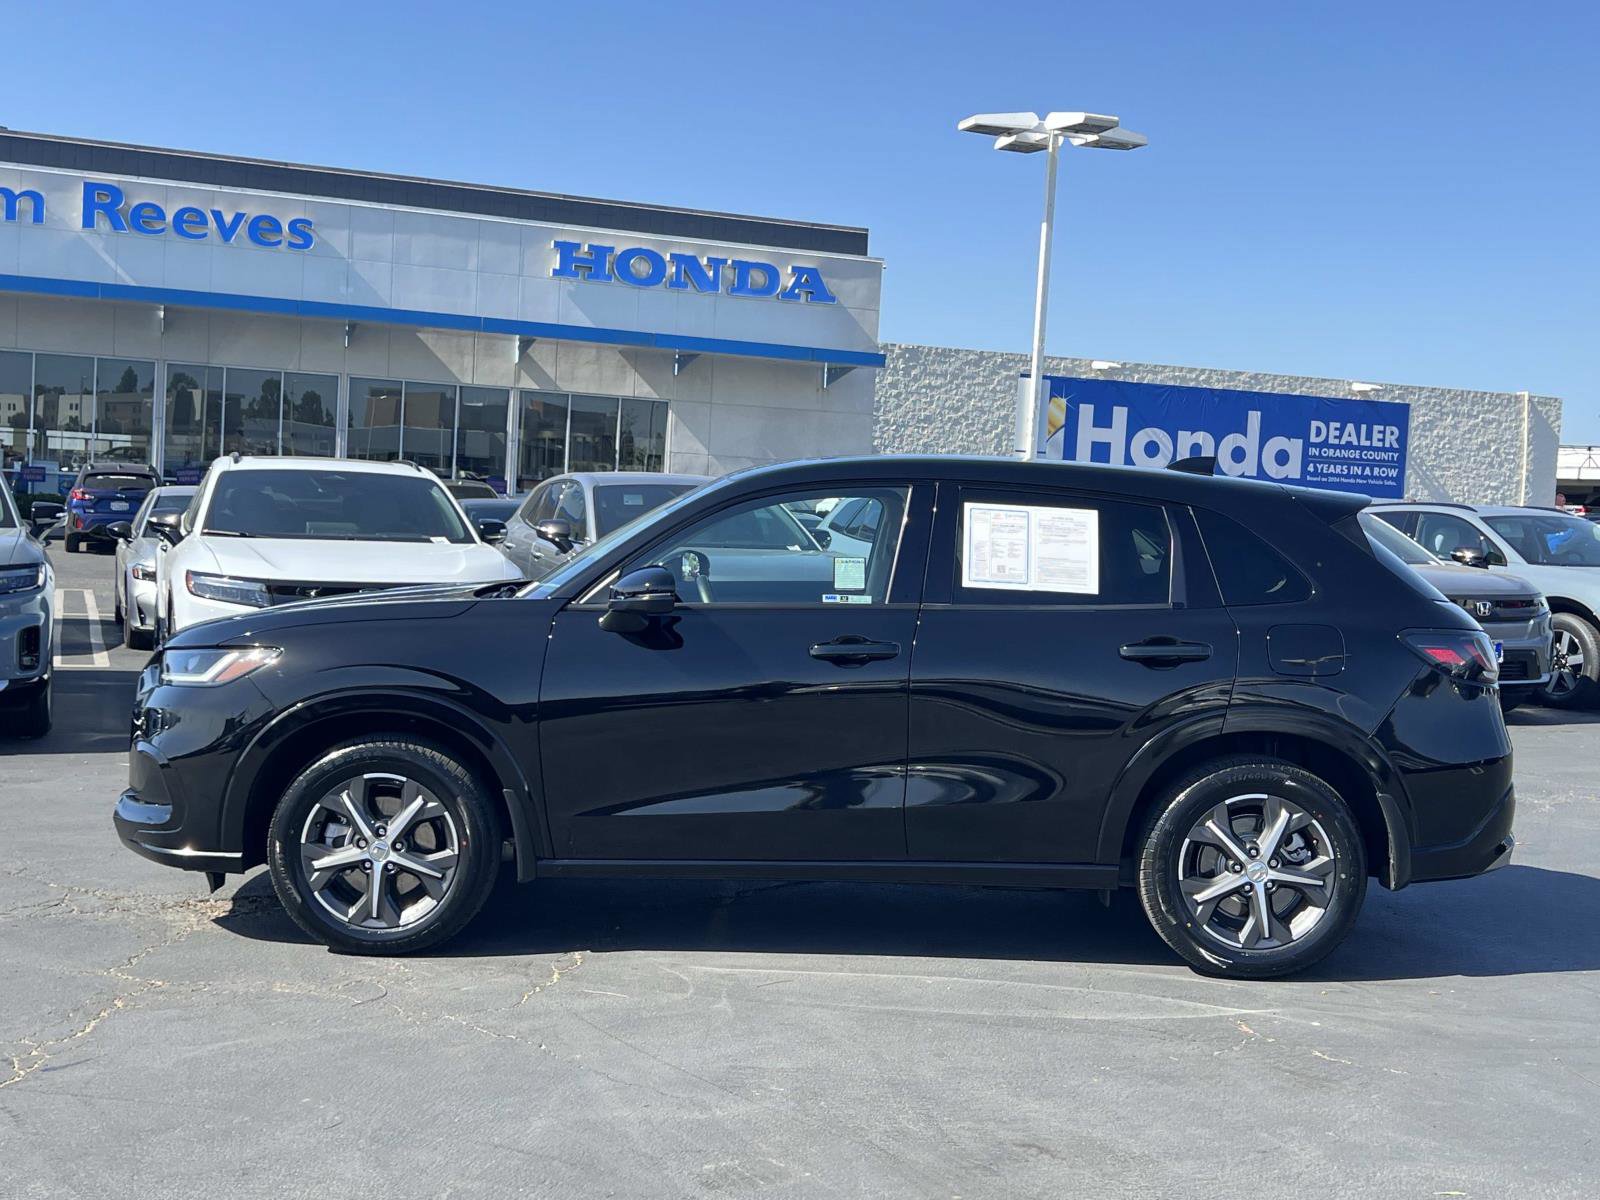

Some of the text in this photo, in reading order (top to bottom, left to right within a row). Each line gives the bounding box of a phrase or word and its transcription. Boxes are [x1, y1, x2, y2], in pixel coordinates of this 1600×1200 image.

[81, 181, 316, 250] Reeves
[550, 239, 837, 304] HONDA
[1076, 403, 1303, 479] Honda
[1308, 447, 1399, 461] IN ORANGE COUNTY
[1309, 420, 1399, 448] DEALER
[1307, 463, 1399, 478] 4 YEARS IN A ROW
